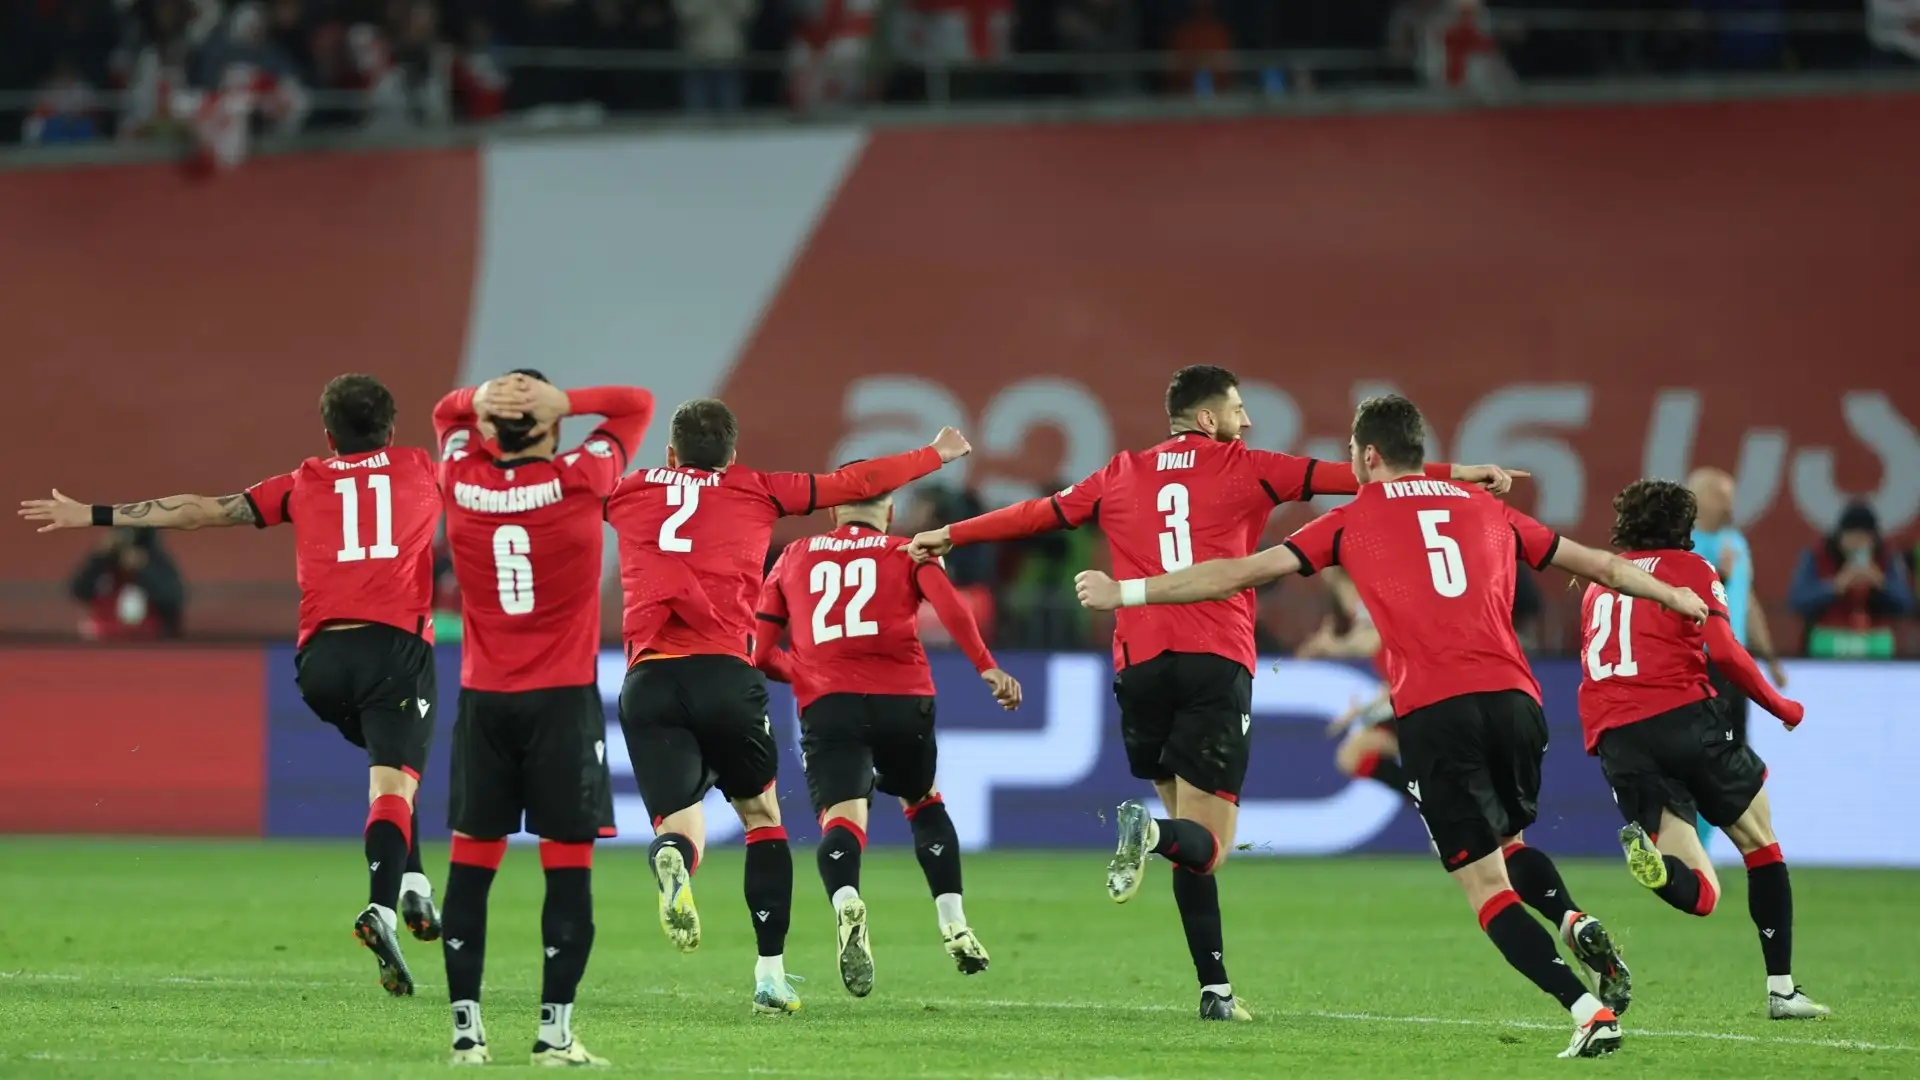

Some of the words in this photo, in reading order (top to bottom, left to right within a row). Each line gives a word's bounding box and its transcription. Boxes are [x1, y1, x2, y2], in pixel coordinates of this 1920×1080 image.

[1157, 450, 1196, 471] DVALI
[335, 474, 399, 563] 11
[658, 484, 700, 553] 2
[1157, 483, 1194, 574] 3
[1416, 509, 1468, 598] 5
[492, 524, 535, 616] 6
[809, 557, 879, 646] 22
[1587, 592, 1638, 682] 21
